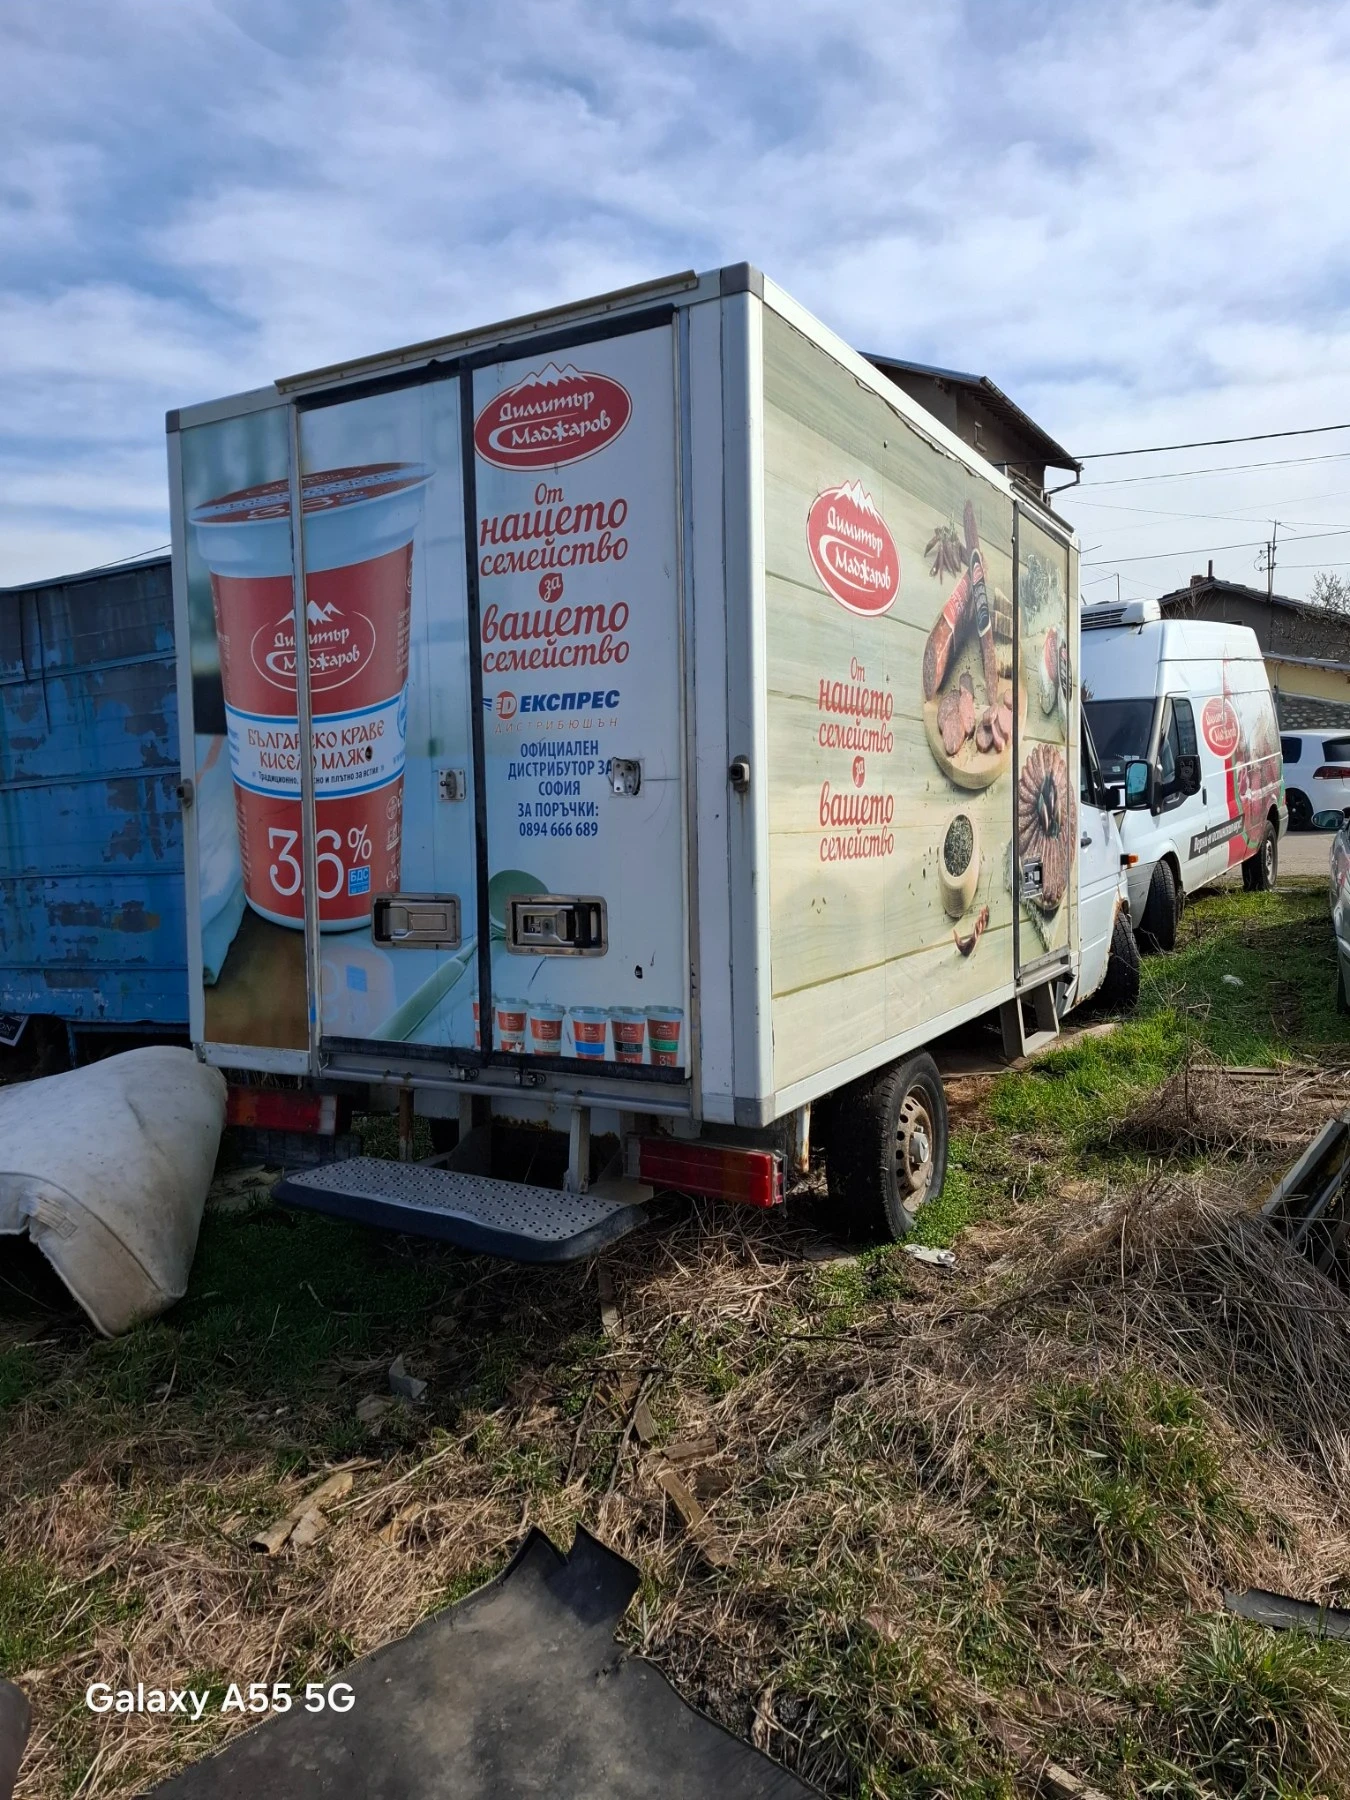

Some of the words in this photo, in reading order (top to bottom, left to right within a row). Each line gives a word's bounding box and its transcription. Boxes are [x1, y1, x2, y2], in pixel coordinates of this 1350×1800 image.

[499, 390, 595, 422] Димитър
[511, 410, 611, 447] Маджаров
[534, 483, 564, 505] От
[827, 506, 883, 558] Димитър
[480, 531, 628, 576] семейство
[835, 546, 891, 590] Маджаров
[543, 576, 562, 600] за
[274, 628, 350, 647] Диитър
[284, 644, 360, 671] Мджаров
[482, 634, 630, 673] семейство
[850, 656, 866, 682] От
[520, 690, 620, 712] ЕКСПРЕС
[341, 720, 385, 745] КРАВЕ
[495, 717, 617, 735] ДИСТРИБЮШЪН
[818, 720, 894, 753] семейство
[520, 739, 599, 760] ОФИЦИАЛЕН
[508, 760, 595, 780] ДИСТРИБУТОР
[538, 780, 580, 796] СОФИЯ
[518, 803, 532, 817] ЗА
[535, 802, 599, 817] ПОРЪЧКИ:
[519, 822, 547, 836] 0894
[550, 822, 573, 836] 666
[575, 821, 598, 836] 689
[820, 825, 894, 862] семейство
[350, 868, 369, 882] БДС
